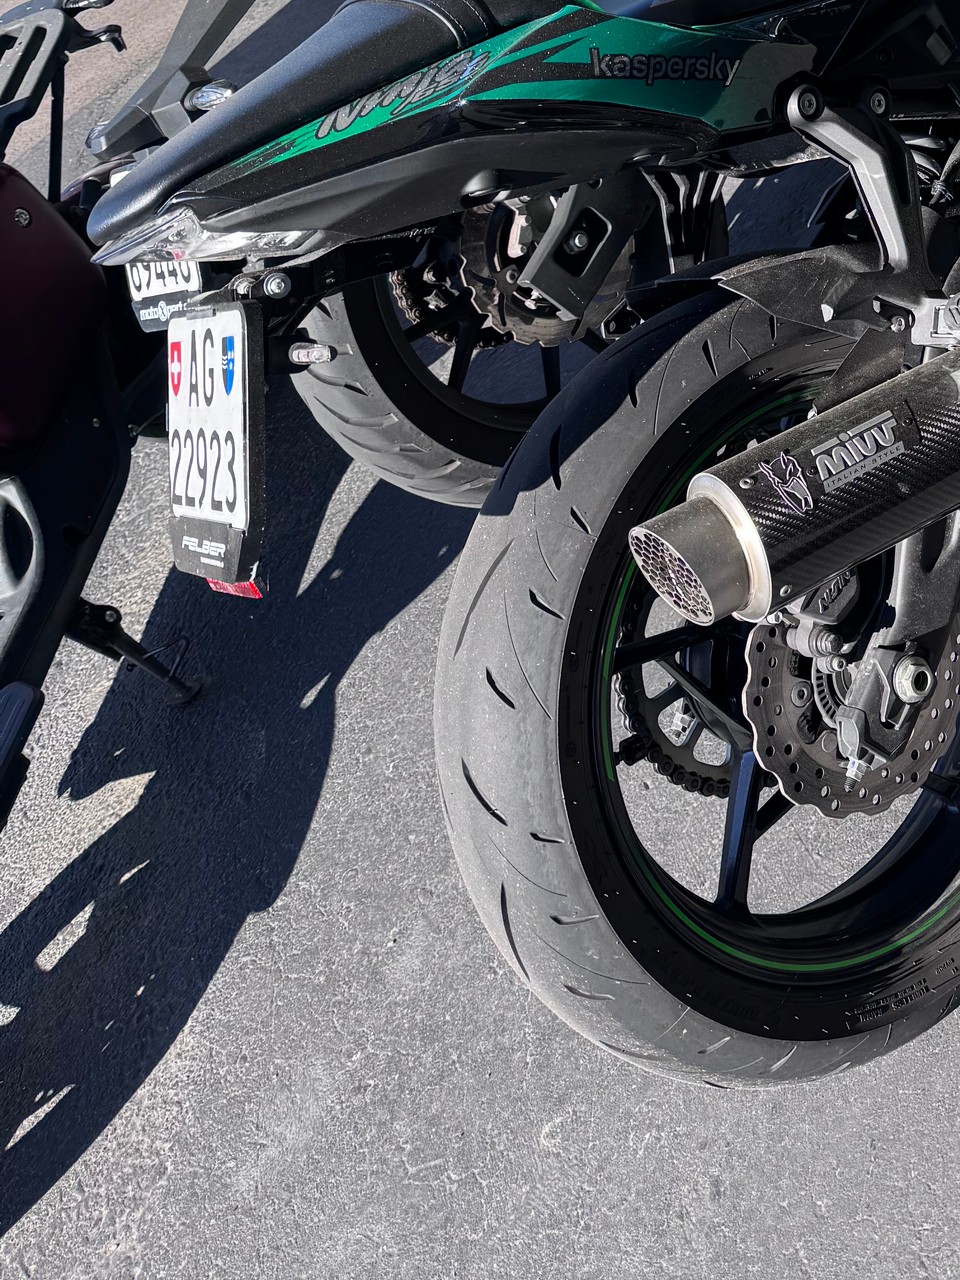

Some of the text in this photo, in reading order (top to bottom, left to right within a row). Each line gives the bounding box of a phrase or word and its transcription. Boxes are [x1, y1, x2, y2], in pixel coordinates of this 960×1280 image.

[314, 49, 476, 139] Ninja
[589, 47, 741, 87] kaspersky
[188, 328, 215, 408] AG
[171, 427, 237, 514] 22923
[826, 445, 902, 489] ITALIAN STYLE
[182, 536, 226, 558] FELBER
